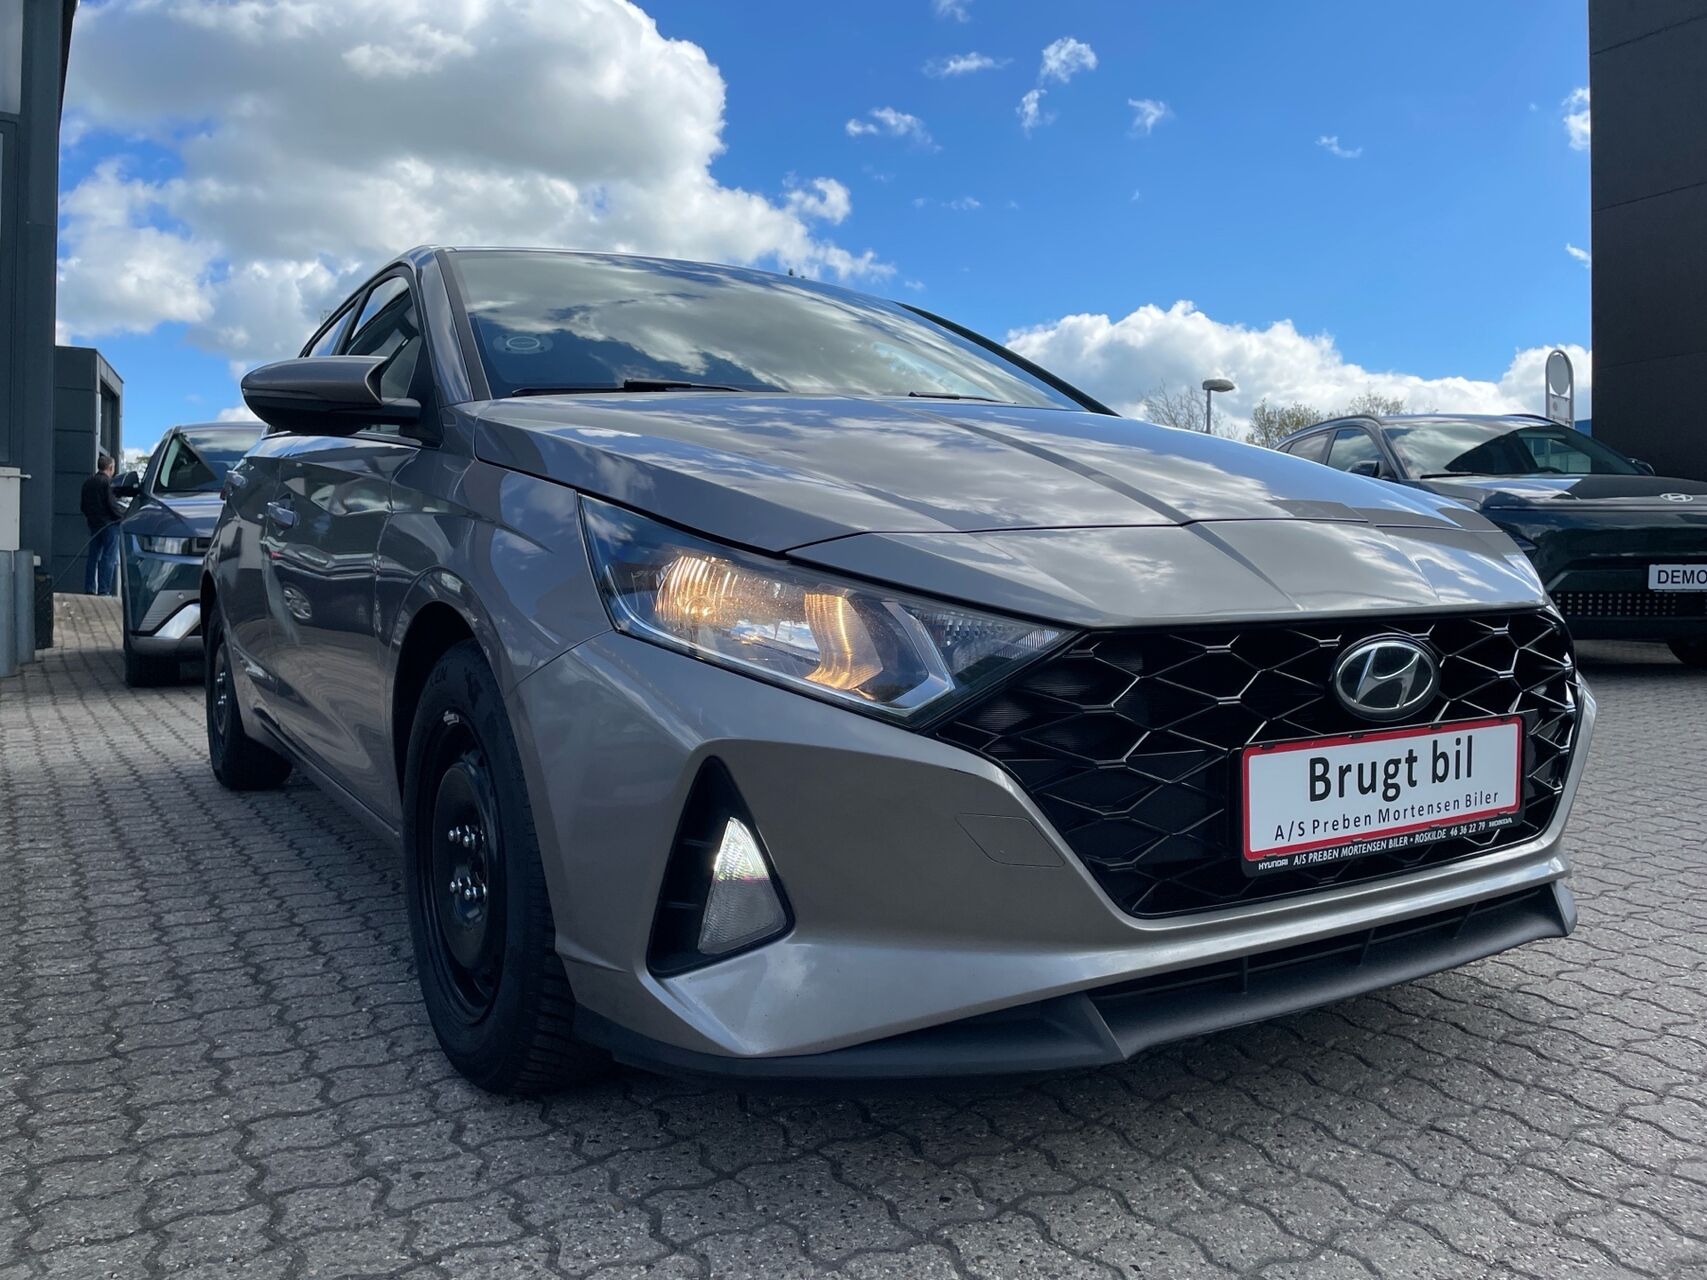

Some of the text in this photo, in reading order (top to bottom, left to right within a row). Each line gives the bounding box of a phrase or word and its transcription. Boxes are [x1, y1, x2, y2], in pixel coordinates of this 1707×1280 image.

[1657, 569, 1707, 585] DEMO
[1309, 735, 1473, 803] Brugt bil
[1274, 790, 1499, 842] A/S Preben Mortensen Biler
[1258, 858, 1289, 871] HYUNDAI
[1293, 854, 1307, 867] A/S
[1308, 848, 1339, 864] PREBEN
[1340, 839, 1388, 861] MORTENSEN
[1388, 836, 1409, 850] BILER
[1414, 828, 1447, 844] ROSKILDE
[1449, 827, 1458, 837] 46
[1459, 825, 1468, 836] 36
[1468, 824, 1477, 834] 22
[1478, 821, 1486, 831] 79
